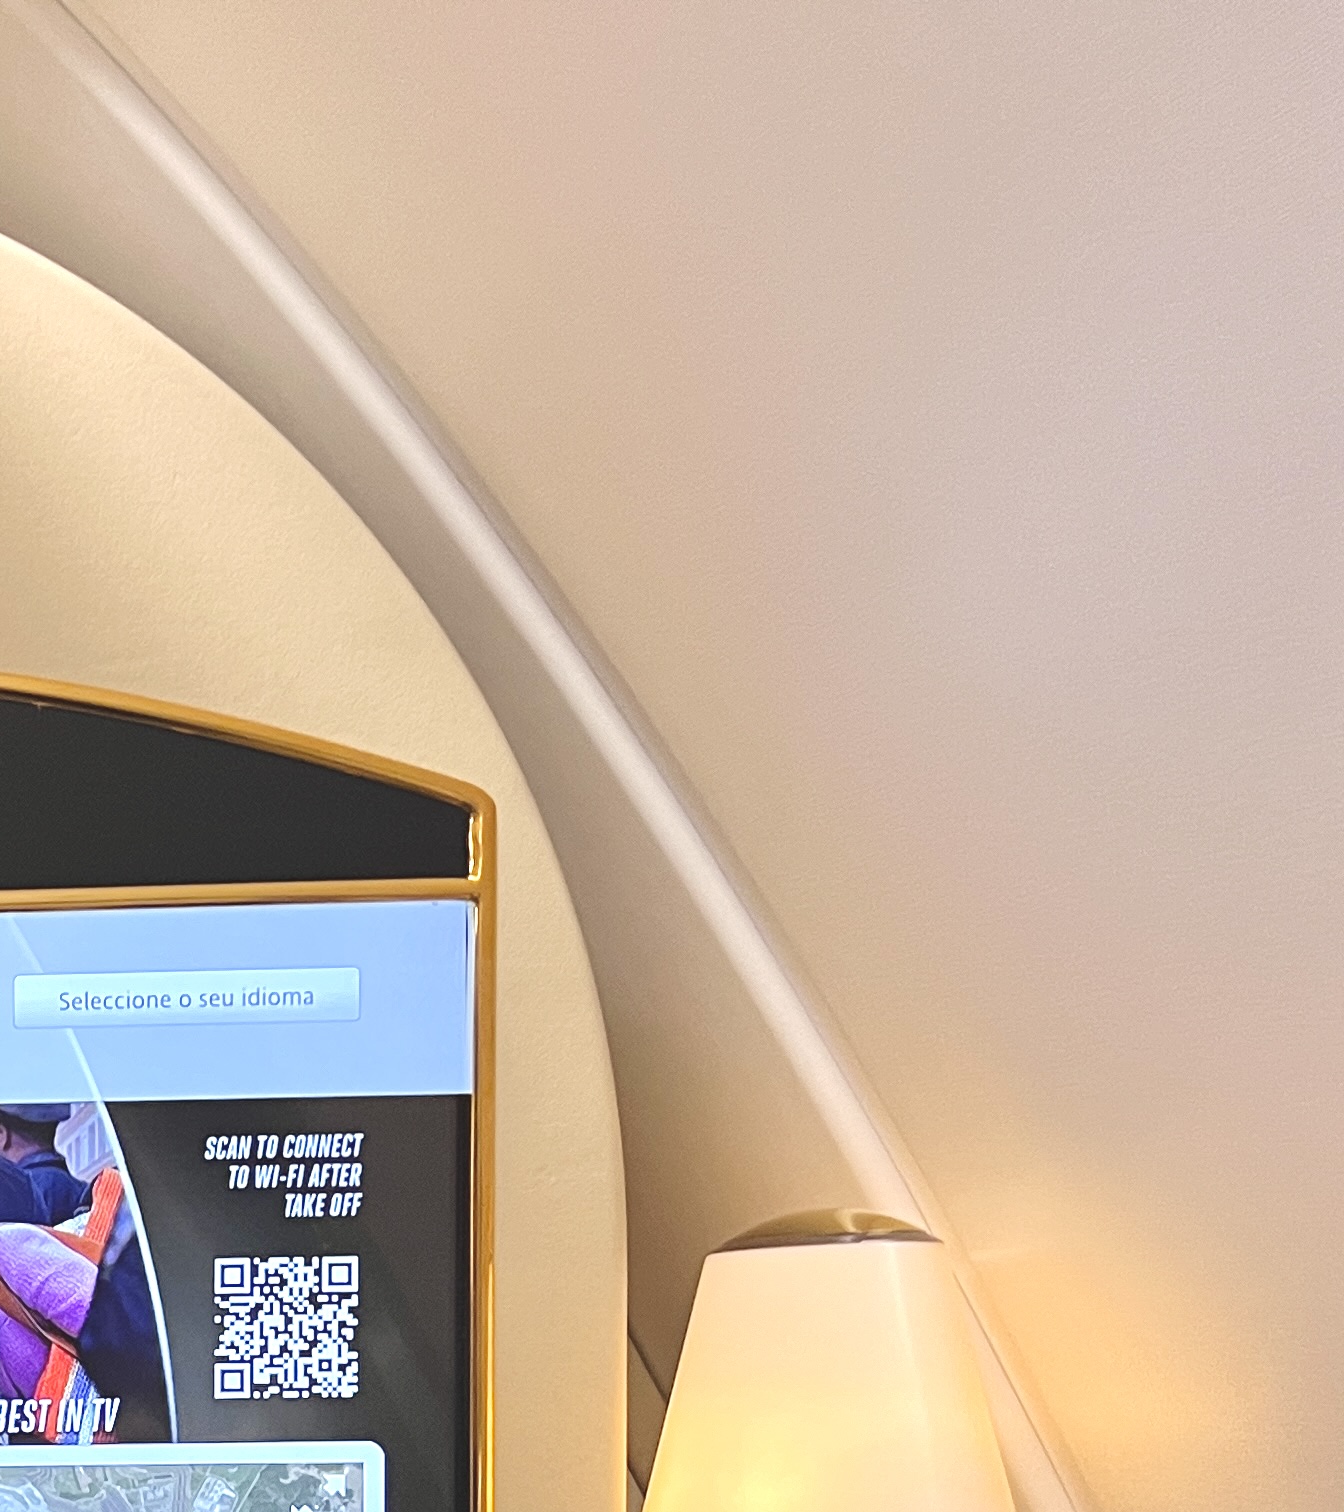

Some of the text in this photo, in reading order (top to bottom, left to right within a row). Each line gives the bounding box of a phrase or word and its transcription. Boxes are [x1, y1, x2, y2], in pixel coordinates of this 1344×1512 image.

[58, 986, 315, 1012] Seleccione o seu idioma
[203, 1131, 365, 1161] SCAN TO CONNECT
[228, 1162, 363, 1190] TO WI-FI AFTER
[283, 1191, 364, 1218] TAKE OFF
[56, 1398, 86, 1434] IN
[91, 1396, 122, 1433] TV
